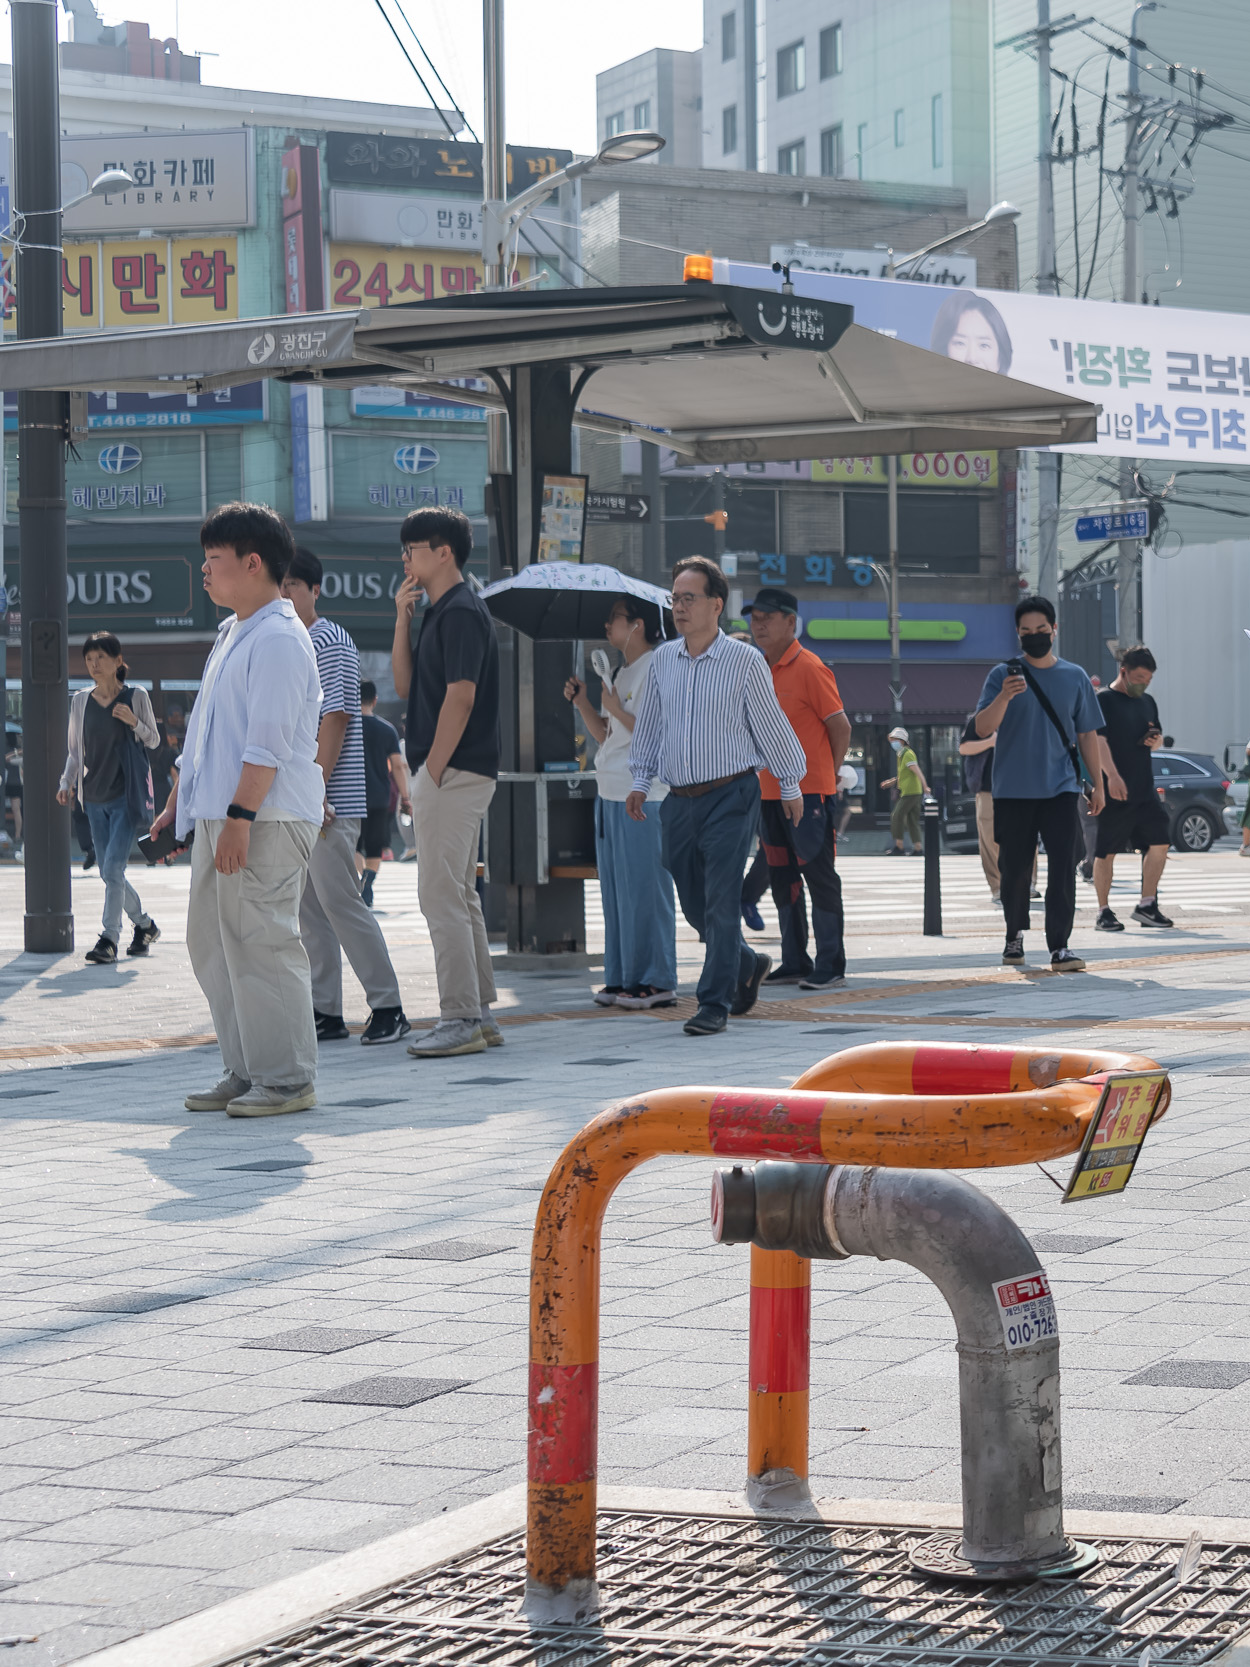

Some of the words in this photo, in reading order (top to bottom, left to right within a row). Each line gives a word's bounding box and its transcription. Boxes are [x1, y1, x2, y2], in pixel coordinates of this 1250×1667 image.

[434, 150, 560, 185] 노방
[104, 190, 214, 205] LIBRARY
[437, 209, 483, 229] 만화
[438, 231, 478, 240] LIBR
[287, 227, 300, 312] 롯데리
[333, 258, 520, 306] 24시만
[3, 251, 235, 318] 시만화
[280, 331, 327, 351] 광진구
[88, 412, 192, 429] T.446-2818
[415, 406, 487, 421] T.446-281
[882, 452, 992, 482] ,000원
[72, 483, 167, 509] 혜민치과
[368, 483, 465, 508] 혜민치과
[320, 571, 383, 600] OUS
